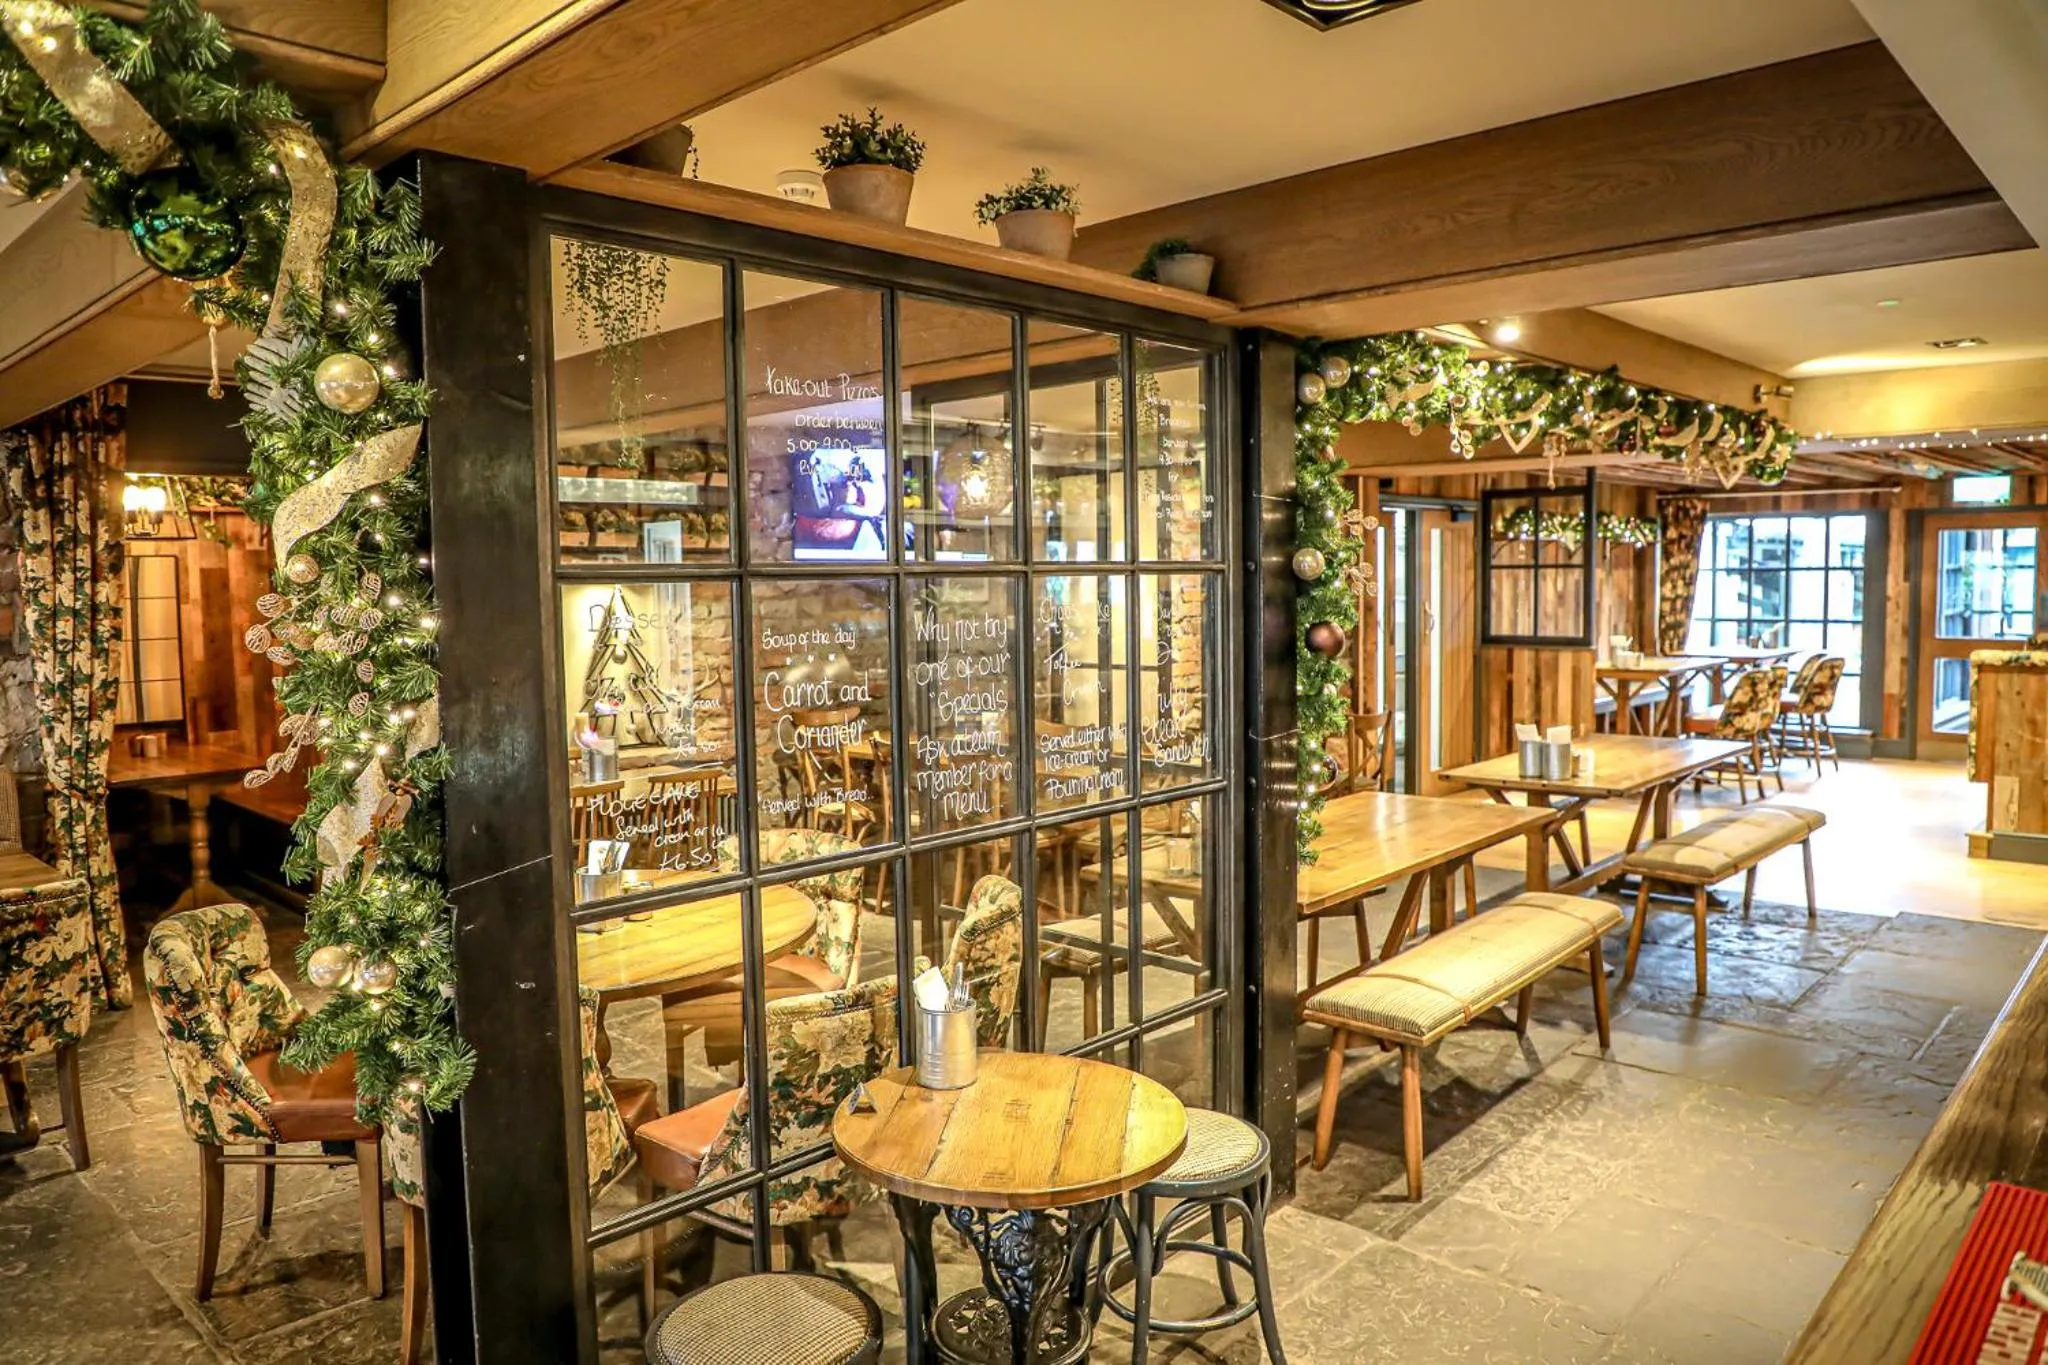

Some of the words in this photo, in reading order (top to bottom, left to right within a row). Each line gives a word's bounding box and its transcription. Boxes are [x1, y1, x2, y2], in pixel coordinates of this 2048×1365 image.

[762, 628, 797, 653] Soup
[798, 633, 809, 652] of
[811, 629, 831, 645] the
[835, 627, 857, 650] day
[914, 605, 951, 665] Why
[955, 616, 980, 653] not
[984, 611, 1008, 648] try
[915, 659, 951, 687] one
[956, 655, 973, 690] of
[977, 651, 1011, 675] our
[764, 670, 833, 713] Carrot
[840, 668, 871, 703] and
[777, 713, 868, 754] Coriander
[1040, 730, 1076, 753] Served
[1077, 726, 1106, 747] either
[1142, 713, 1186, 745] Steak
[916, 734, 950, 766] Ask
[961, 727, 1006, 758] team
[1097, 749, 1110, 764] or
[1154, 734, 1213, 768] Sandwich
[916, 762, 977, 800] member
[978, 759, 1002, 790] for
[804, 788, 832, 808] with
[664, 807, 695, 828] with
